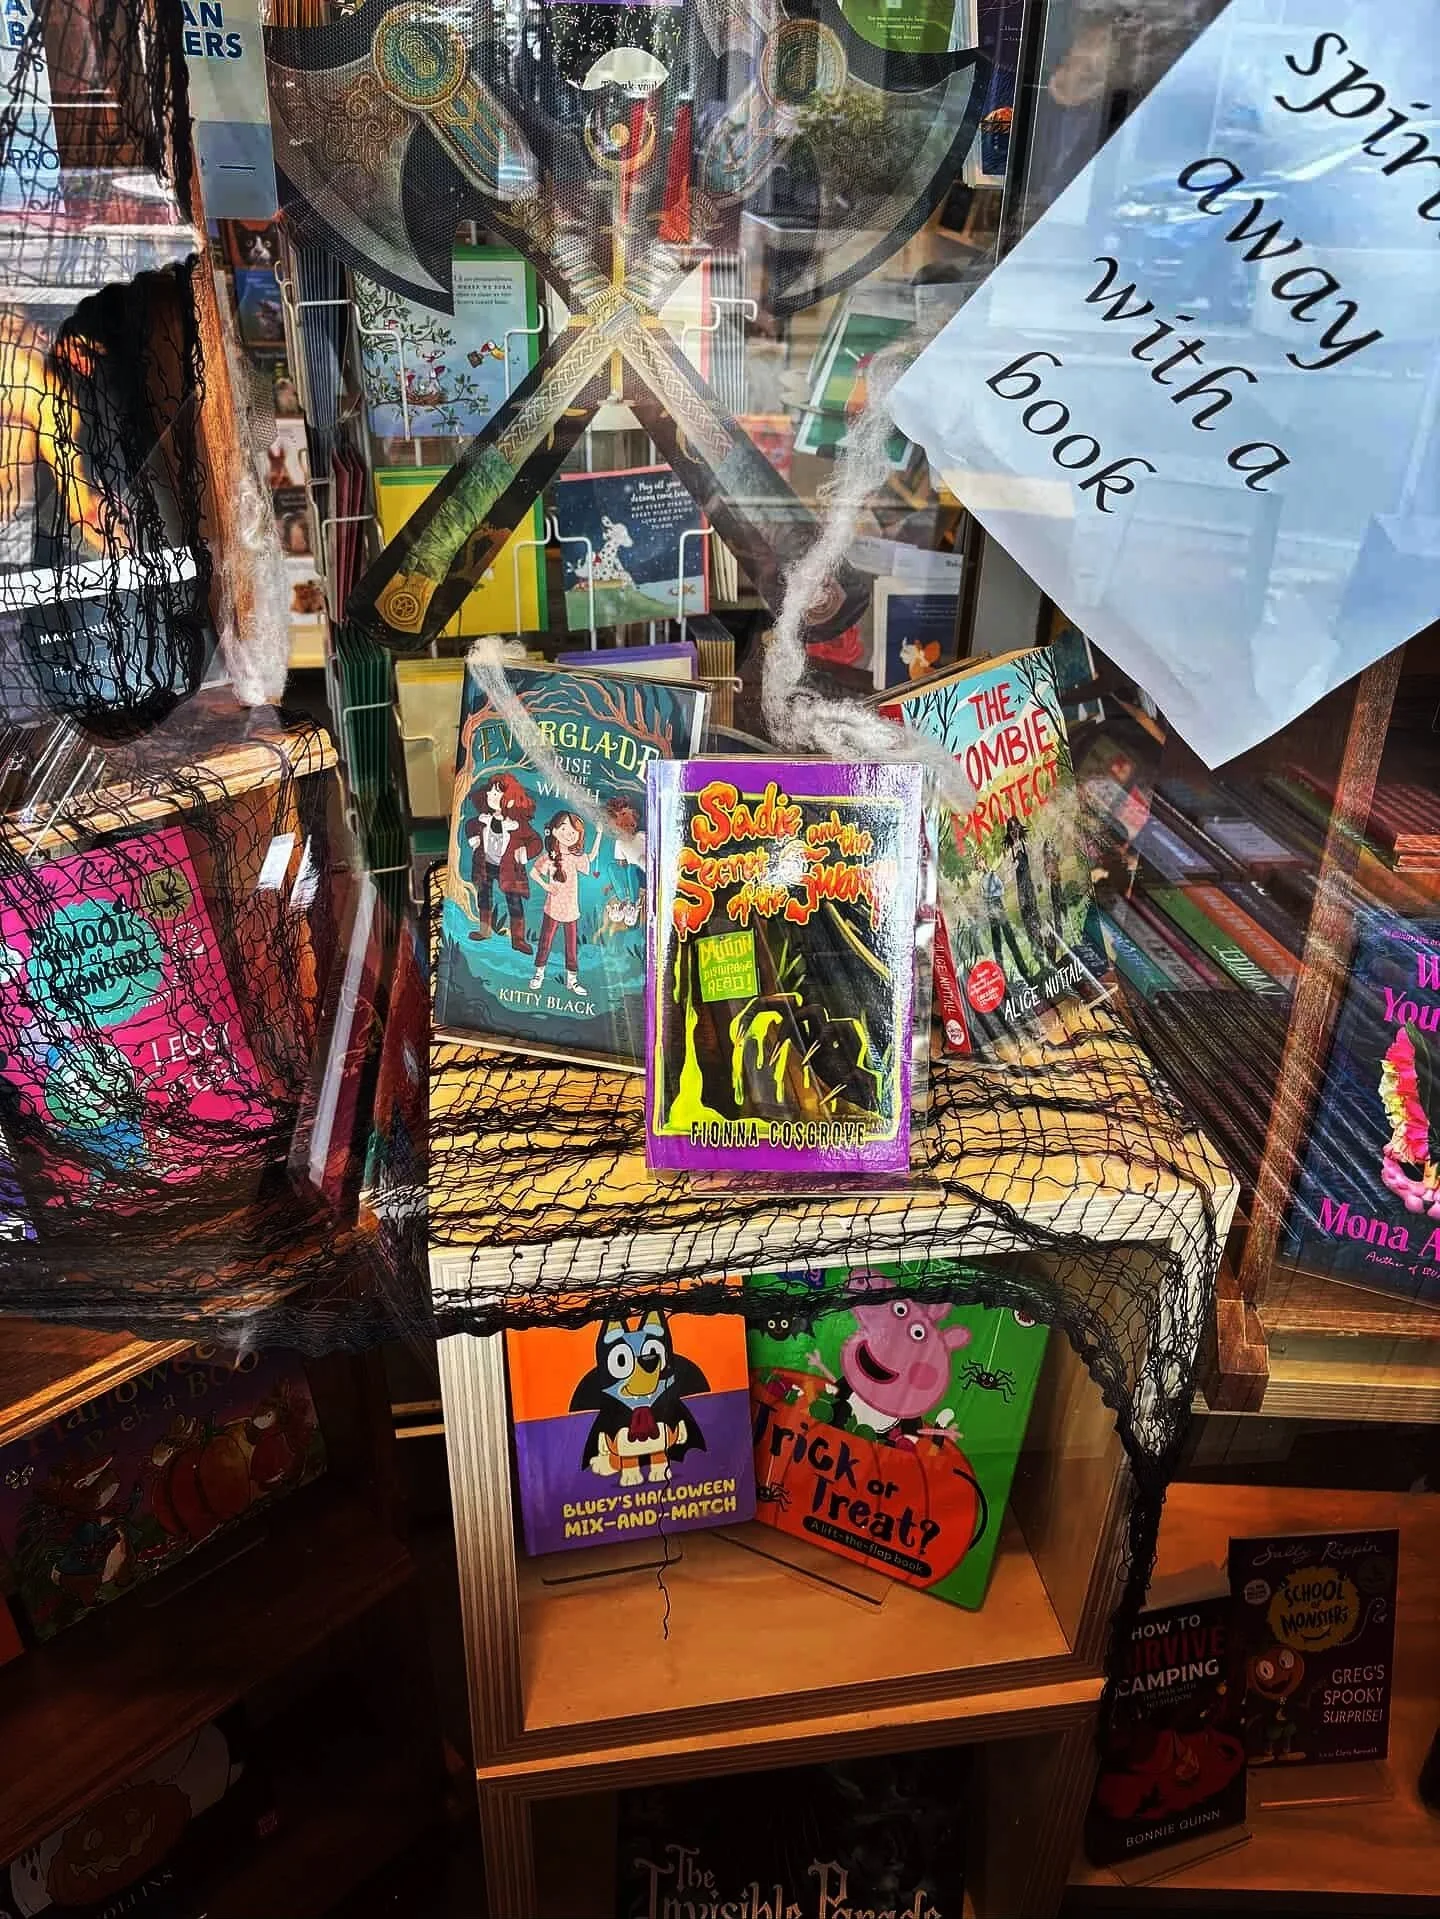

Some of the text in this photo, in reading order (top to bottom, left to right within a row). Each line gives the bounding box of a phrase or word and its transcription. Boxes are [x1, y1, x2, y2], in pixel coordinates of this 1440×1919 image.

[1176, 156, 1384, 371] away
[1085, 256, 1290, 492] with a
[985, 351, 1158, 513] book
[968, 683, 1017, 730] THE
[478, 720, 660, 784] EVRGLADE
[553, 754, 592, 777] RISE
[952, 708, 1055, 792] OMBIE
[536, 780, 600, 805] WIH
[691, 781, 803, 854] Sadie
[805, 810, 874, 858] and the
[673, 847, 771, 942] Secret
[499, 988, 596, 1016] KITTY BLACK
[1004, 984, 1041, 1021] ALICE
[1045, 957, 1085, 999] NUTTALL
[690, 1120, 867, 1151] FIONNA COSGROVE
[1319, 1197, 1409, 1252] Mona
[752, 1401, 900, 1500] Trick or
[563, 1478, 737, 1519] BLUEY'S HALLOWEEN
[811, 1472, 941, 1556] Treat?
[810, 1520, 925, 1574] A lift-the-flap book
[1284, 1579, 1345, 1608] SCHOOL
[1130, 1613, 1201, 1641] HOW TO
[1279, 1605, 1349, 1639] MONSTERS
[1125, 1626, 1226, 1675] URVIVE
[1331, 1663, 1385, 1685] GREG'S
[1116, 1658, 1220, 1698] CAMPING
[1322, 1687, 1385, 1706] SPOOKY
[1322, 1708, 1384, 1724] SURPRISE!
[1125, 1808, 1221, 1849] BONNIE QUINN
[664, 1843, 718, 1893] The
